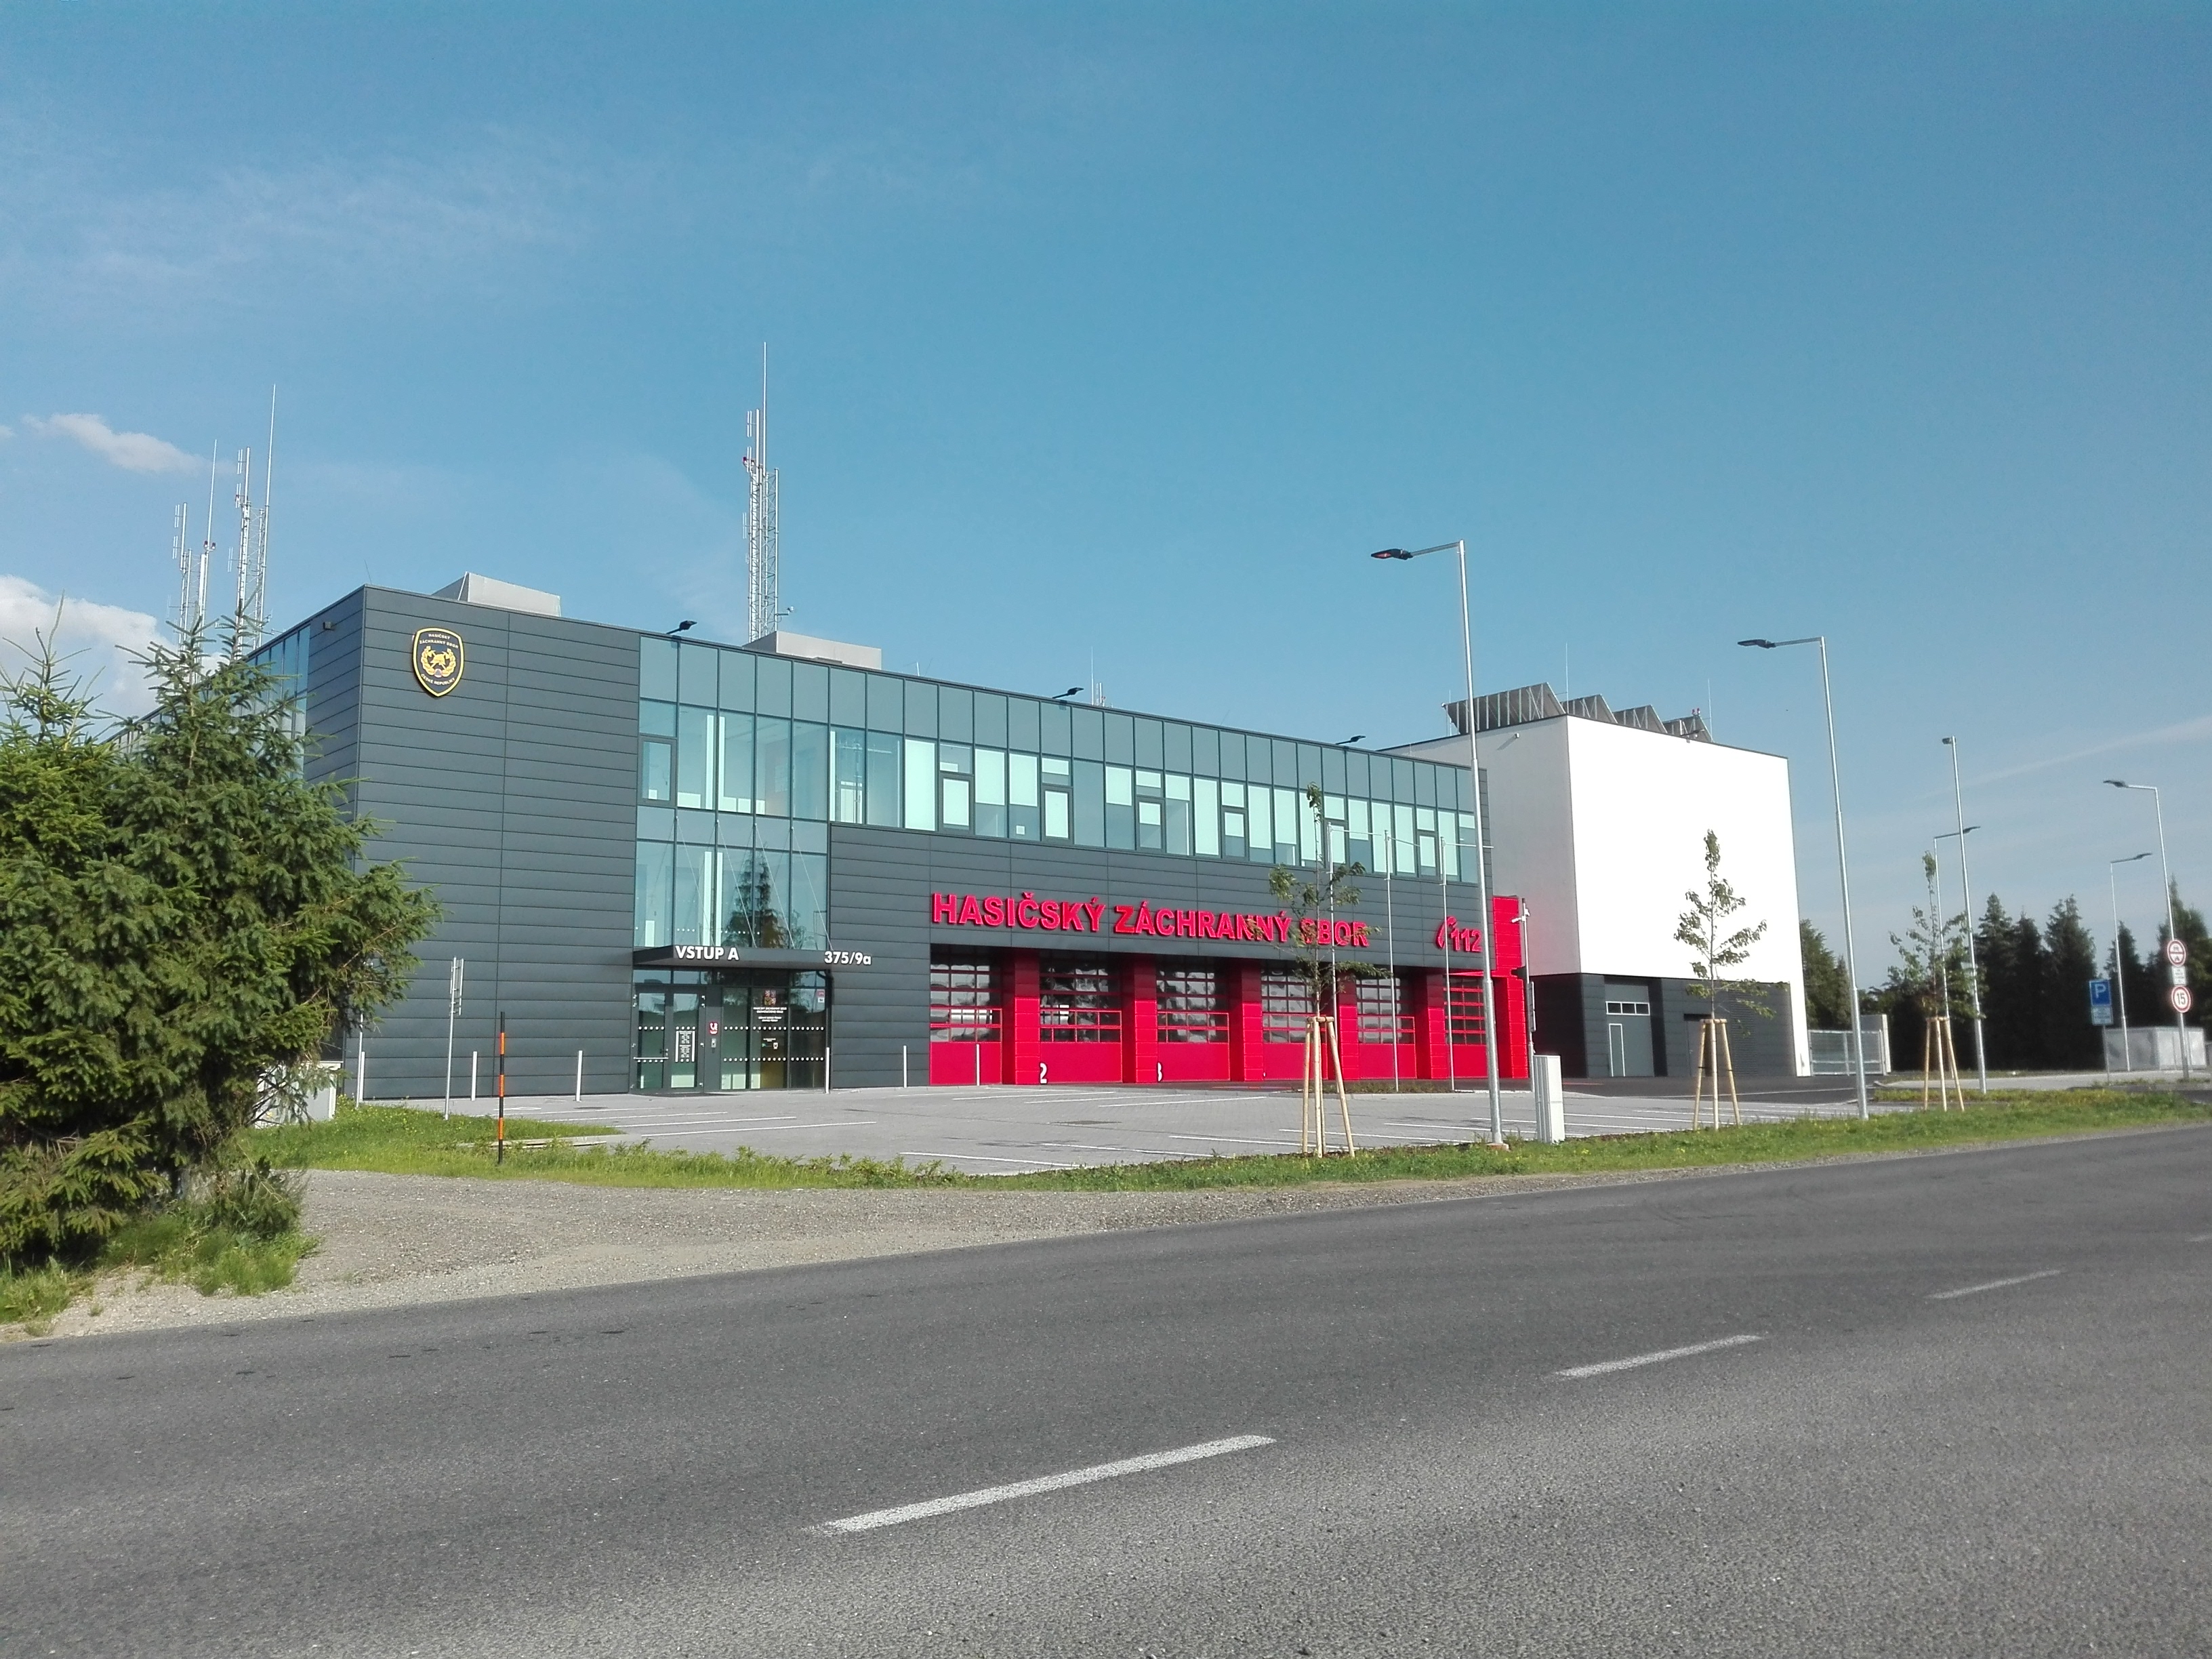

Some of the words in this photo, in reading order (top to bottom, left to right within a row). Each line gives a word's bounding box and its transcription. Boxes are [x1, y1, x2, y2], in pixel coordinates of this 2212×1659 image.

[932, 891, 1106, 932] HASIČSKÝ
[1113, 901, 1292, 942] ZÁCHRANNÝ
[1450, 928, 1483, 952] 112
[675, 945, 724, 960] VSTUP
[727, 947, 739, 960] A
[824, 951, 872, 966] 375/9a
[2095, 983, 2106, 999] P
[2177, 993, 2186, 1005] 15
[1040, 1062, 1048, 1084] 2
